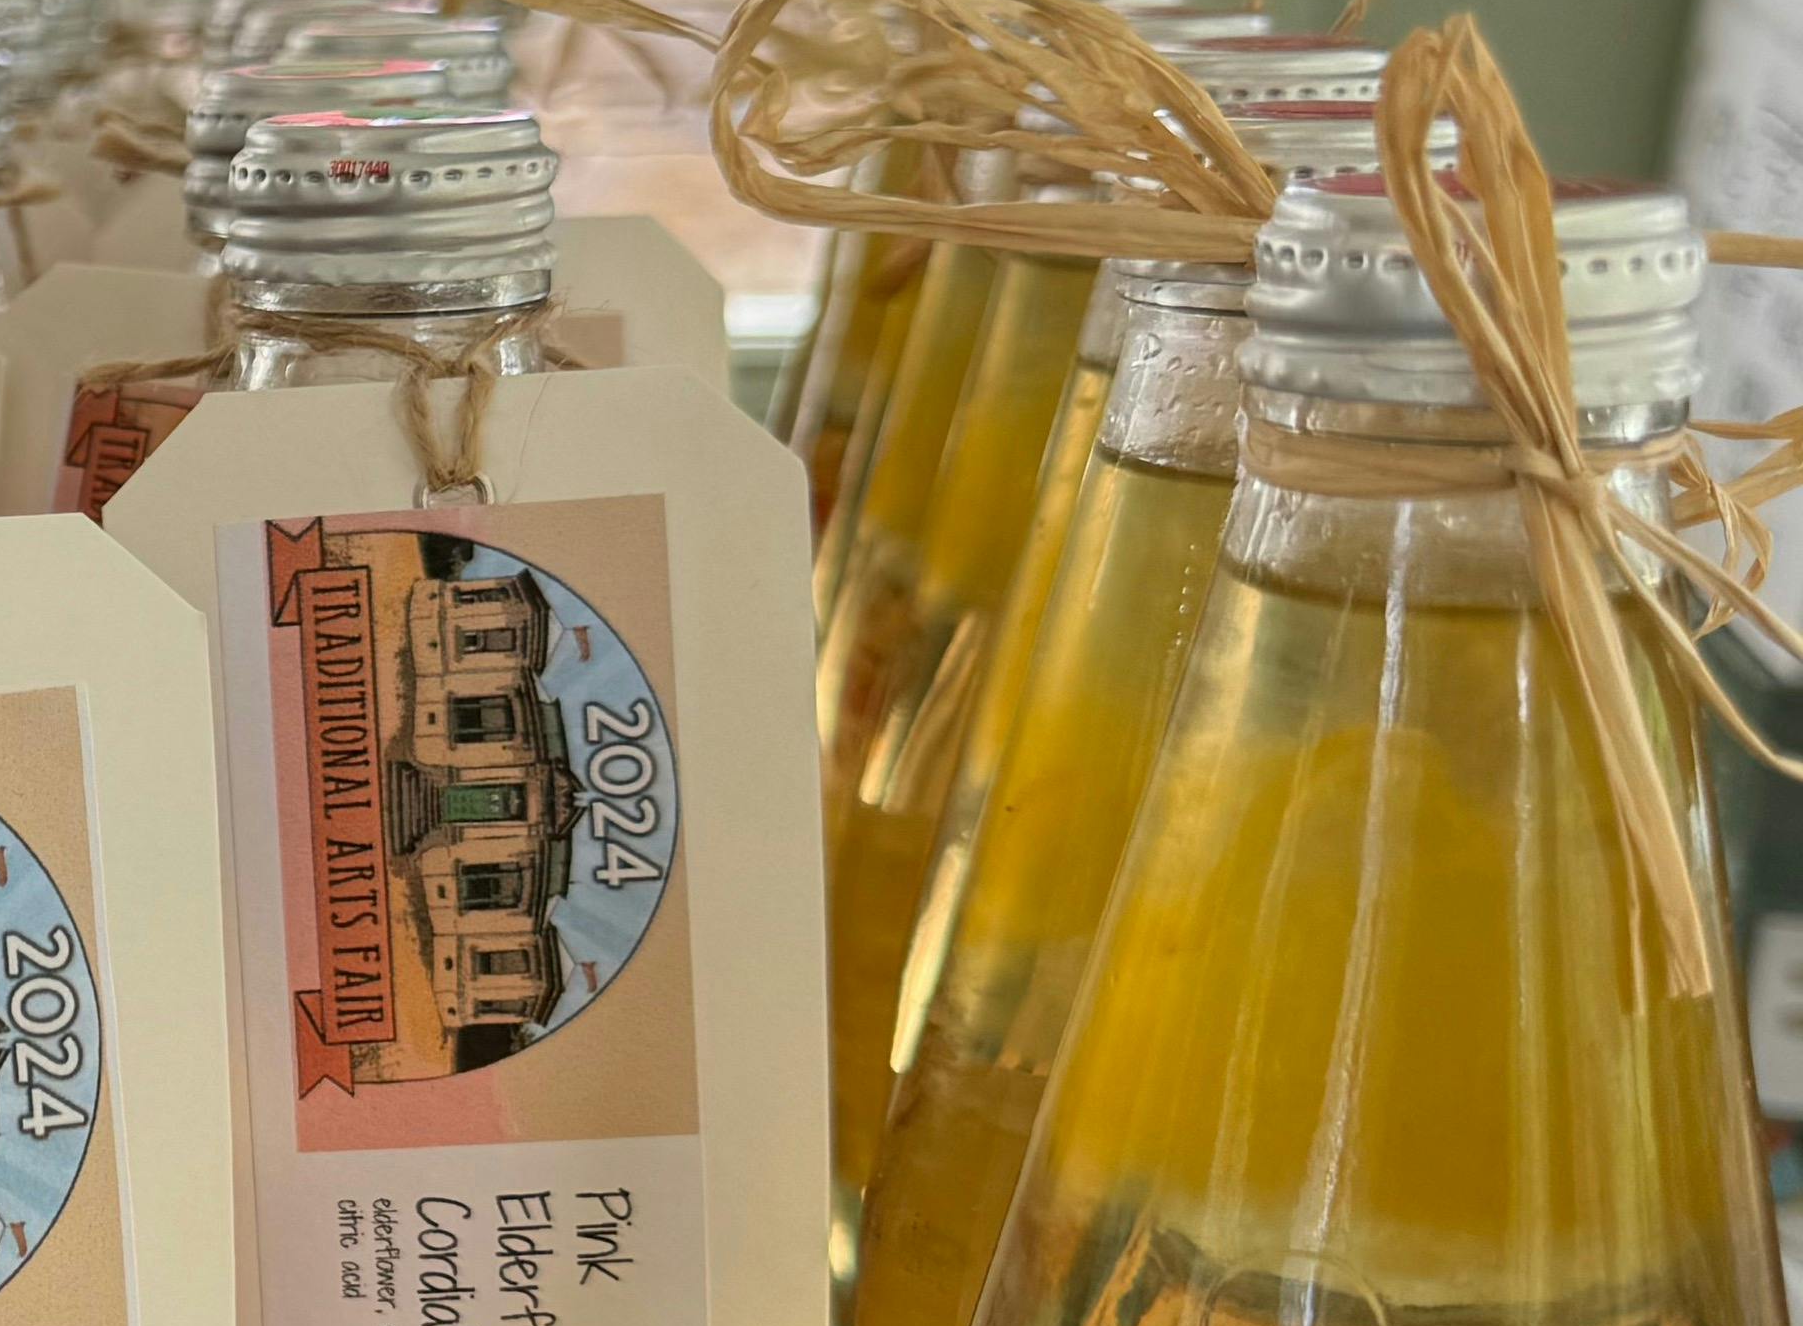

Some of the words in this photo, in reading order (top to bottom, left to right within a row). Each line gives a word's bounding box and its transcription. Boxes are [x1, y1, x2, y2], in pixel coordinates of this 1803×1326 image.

[312, 579, 374, 821] TRADITIONAL
[584, 698, 664, 886] 2024
[325, 837, 379, 930] ARTS
[2, 925, 89, 1141] 2024
[332, 944, 385, 1030] FAIR
[337, 1199, 370, 1249] citric
[575, 1187, 634, 1285] Pink
[340, 1260, 368, 1299] acid
